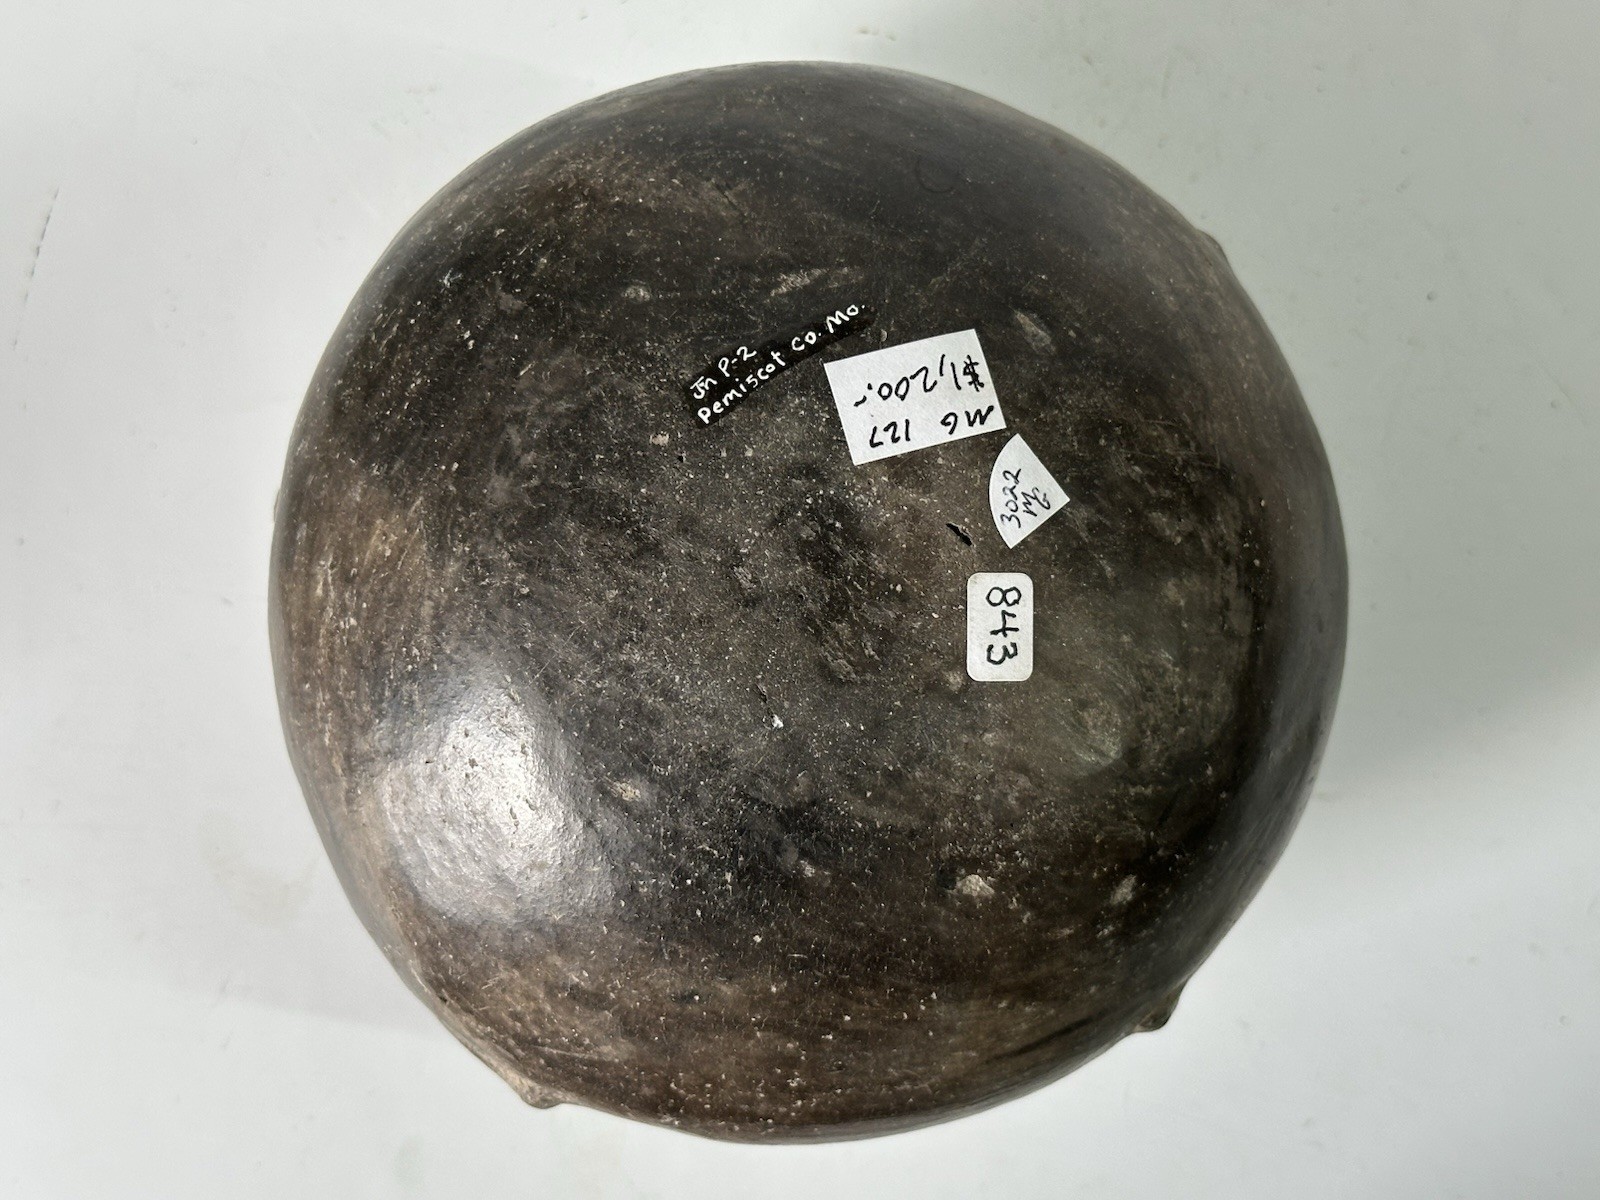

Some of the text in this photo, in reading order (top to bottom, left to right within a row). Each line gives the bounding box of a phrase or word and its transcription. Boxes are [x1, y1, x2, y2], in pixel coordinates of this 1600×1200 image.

[825, 304, 866, 333] Mo.
[868, 405, 995, 449] MG 127
[1000, 468, 1022, 529] 3022
[985, 586, 1022, 666] 843
